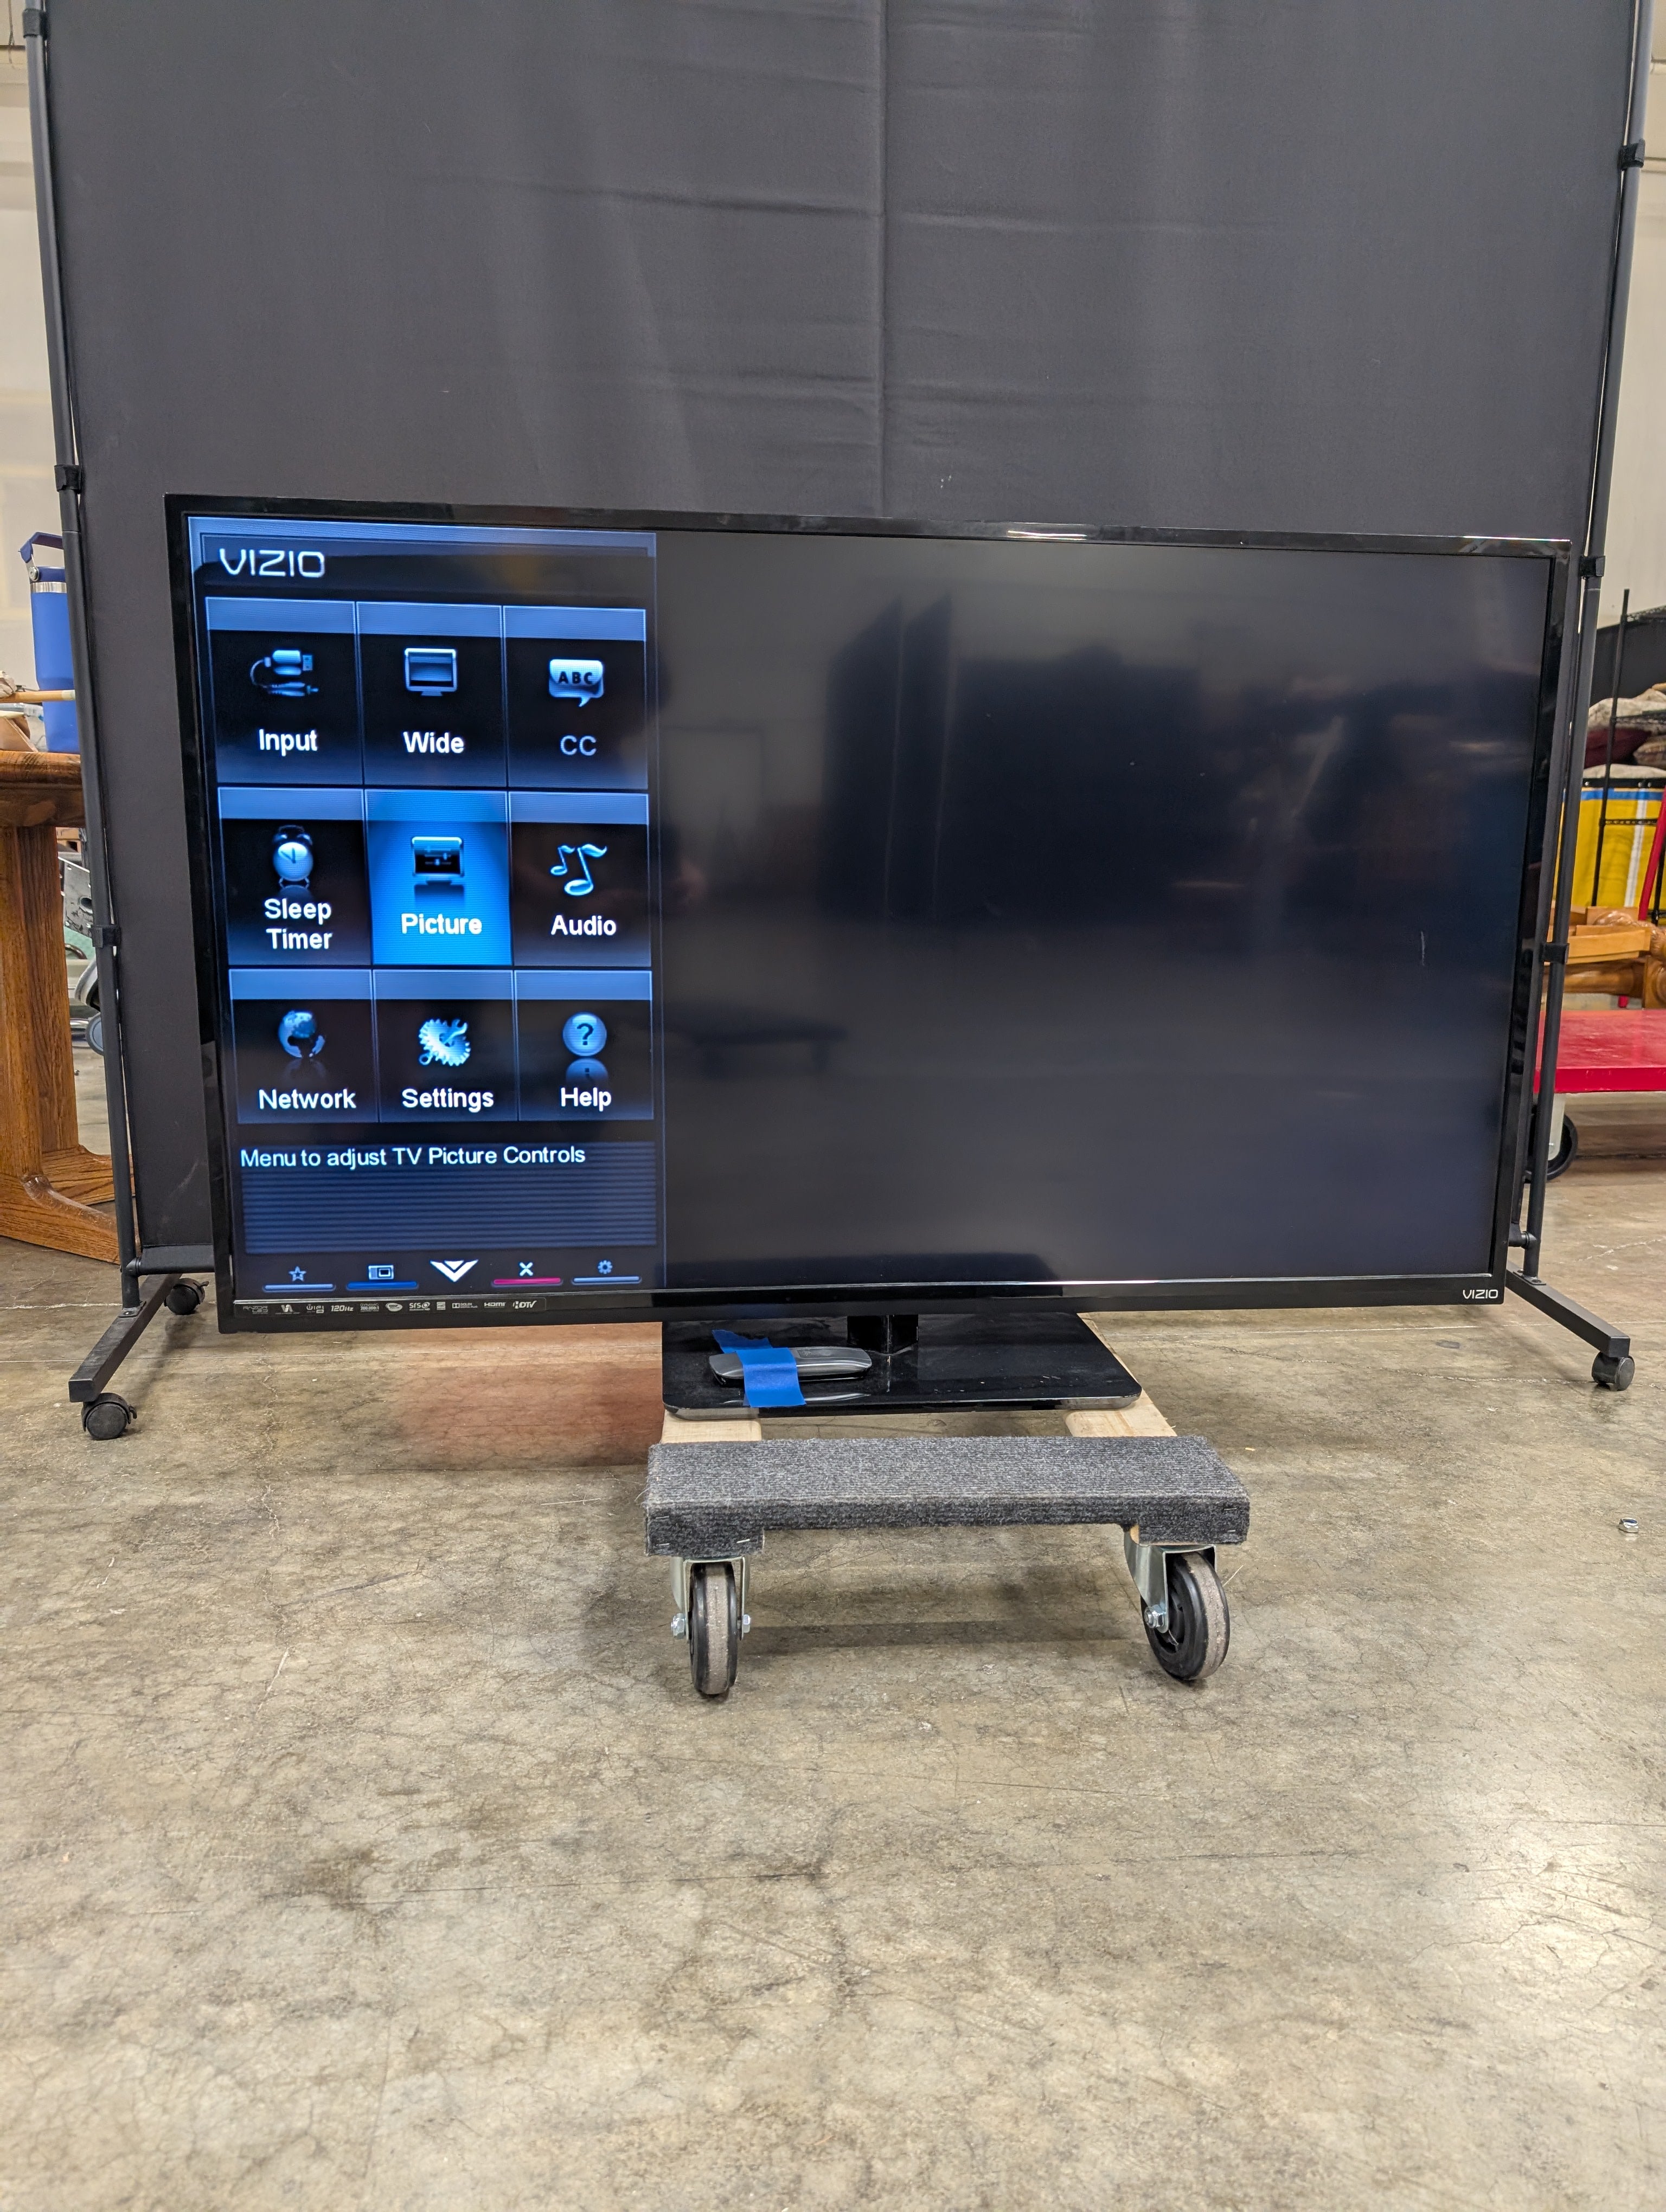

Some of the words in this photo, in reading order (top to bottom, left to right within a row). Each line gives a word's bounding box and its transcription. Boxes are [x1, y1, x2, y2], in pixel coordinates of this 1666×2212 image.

[219, 549, 325, 578] VIZIO
[558, 670, 594, 686] ABC
[259, 729, 318, 756] Input
[403, 731, 464, 754] Wide
[560, 735, 597, 756] CC
[264, 898, 332, 924] Sleep
[402, 914, 482, 935] Picture
[551, 915, 617, 936] Audio
[266, 929, 332, 949] Timer
[259, 1089, 356, 1110] Network
[402, 1089, 494, 1113] Settings
[561, 1088, 612, 1111] Help
[241, 1149, 296, 1167] Menu
[301, 1150, 321, 1166] to
[327, 1148, 387, 1170] adjust
[393, 1148, 422, 1165] TV
[429, 1147, 497, 1164] Picture
[504, 1145, 586, 1163] Controls
[1463, 1289, 1498, 1299] VIZIO
